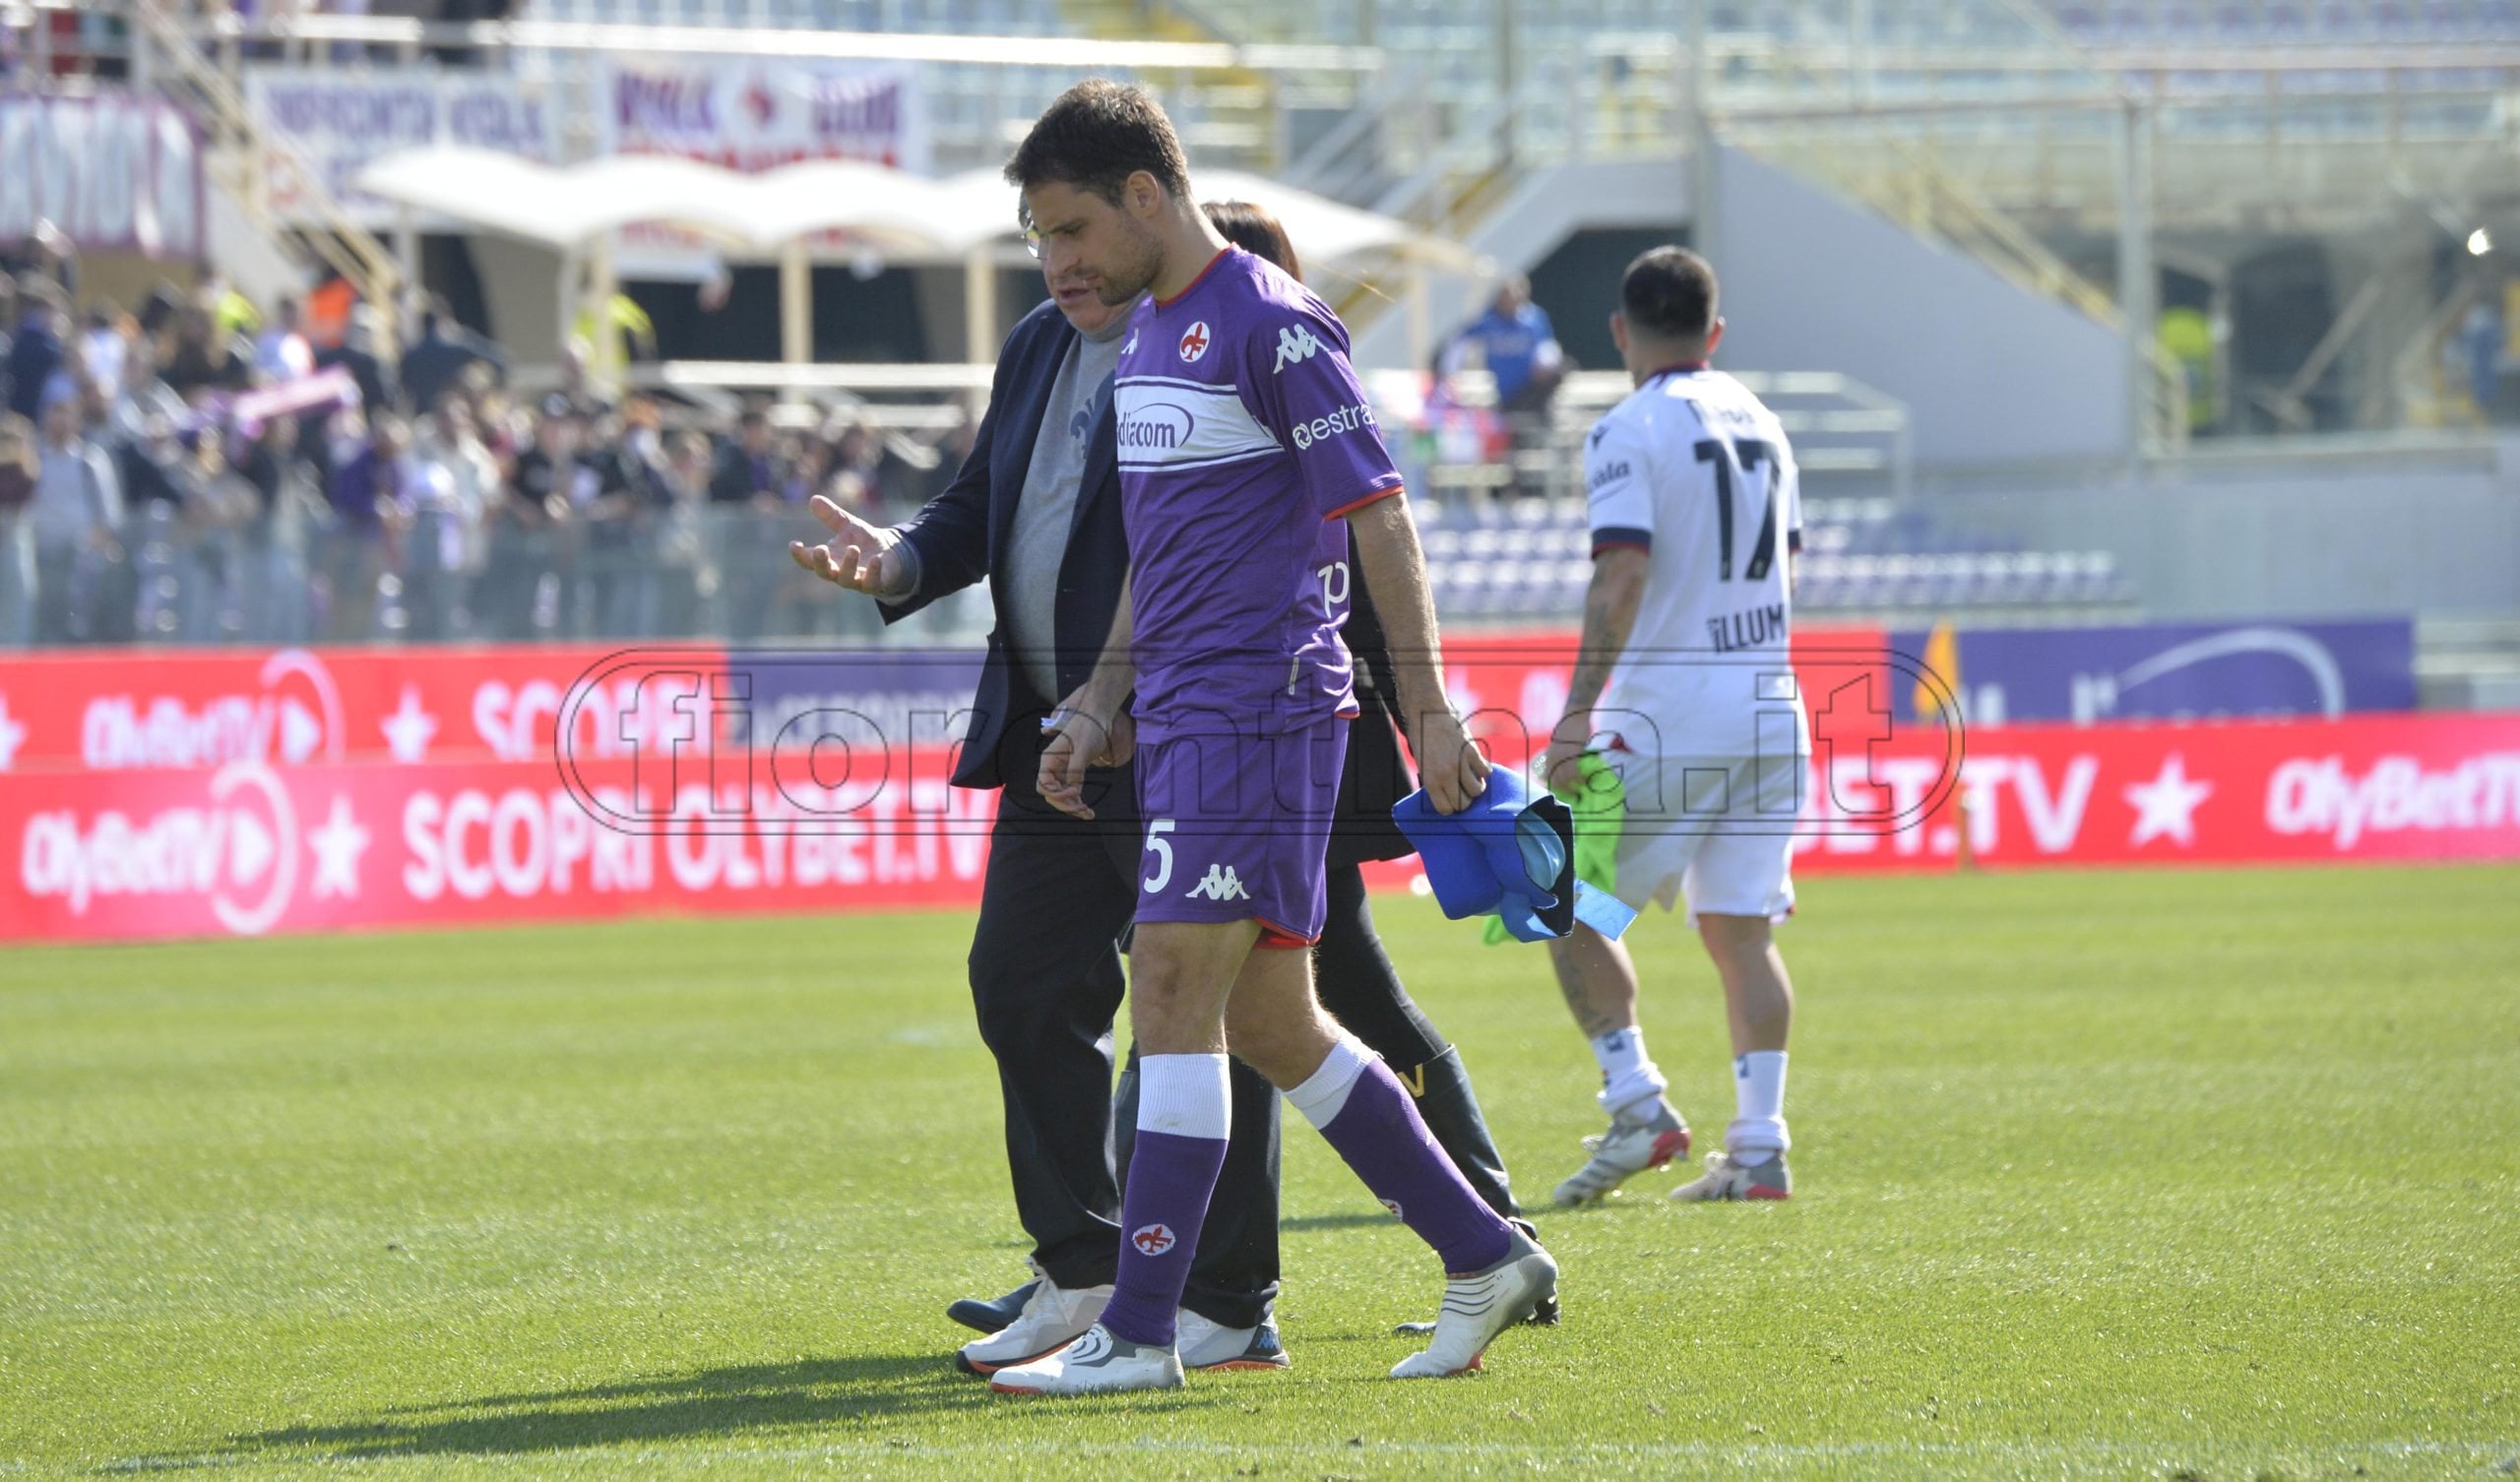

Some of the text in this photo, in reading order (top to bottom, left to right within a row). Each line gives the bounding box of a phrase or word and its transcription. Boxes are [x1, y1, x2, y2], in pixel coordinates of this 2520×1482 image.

[1117, 411, 1175, 448] diacom
[1310, 404, 1375, 440] estra
[1692, 440, 1780, 583] 17
[472, 679, 712, 761] SCOPRI
[403, 778, 991, 900] SCOPRI OLYBET.TV
[1143, 819, 1175, 893] 5
